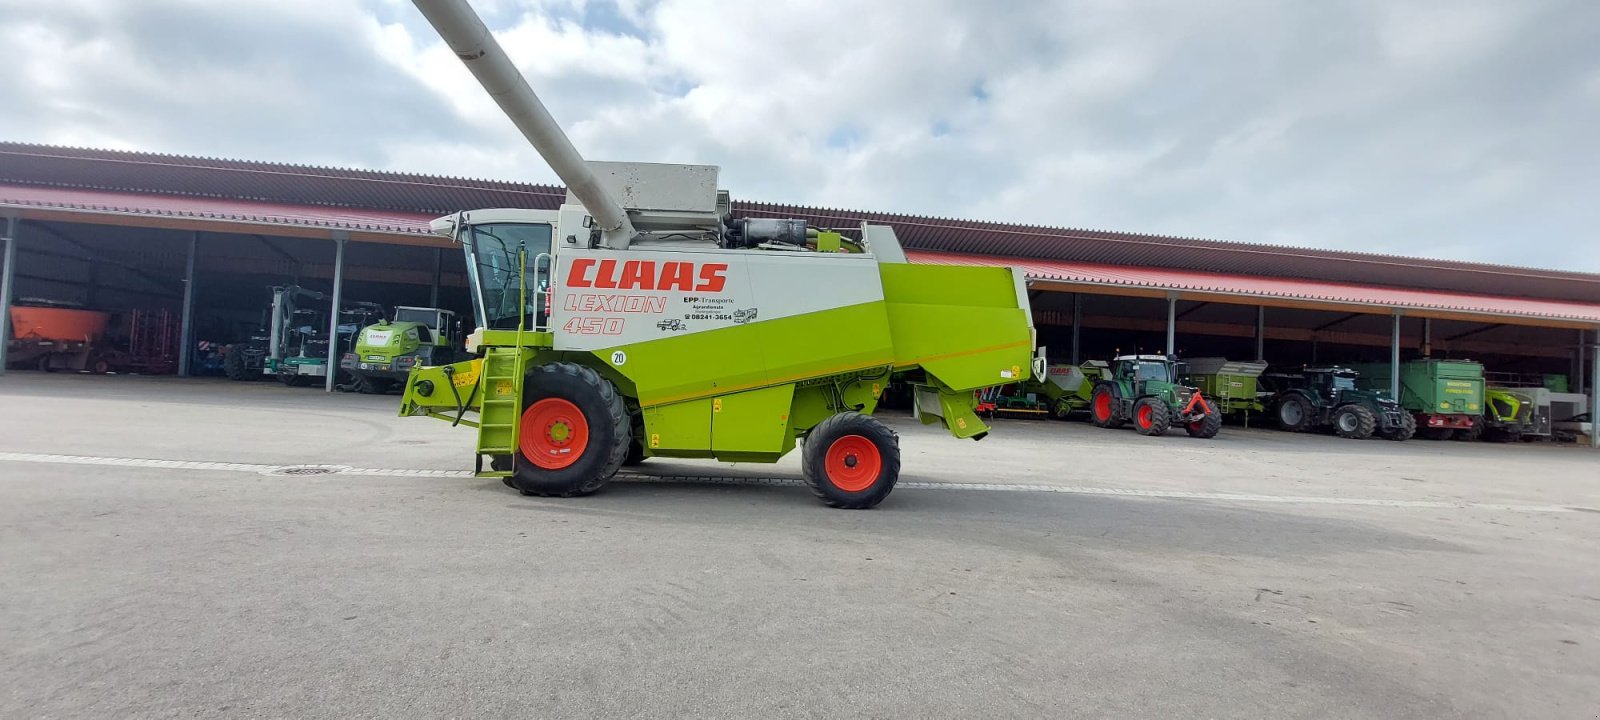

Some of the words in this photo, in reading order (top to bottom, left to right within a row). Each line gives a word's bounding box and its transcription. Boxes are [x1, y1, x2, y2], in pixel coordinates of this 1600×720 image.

[566, 258, 729, 293] CLAAS
[563, 294, 668, 314] LEXION
[563, 317, 626, 335] 450
[614, 353, 624, 363] 20
